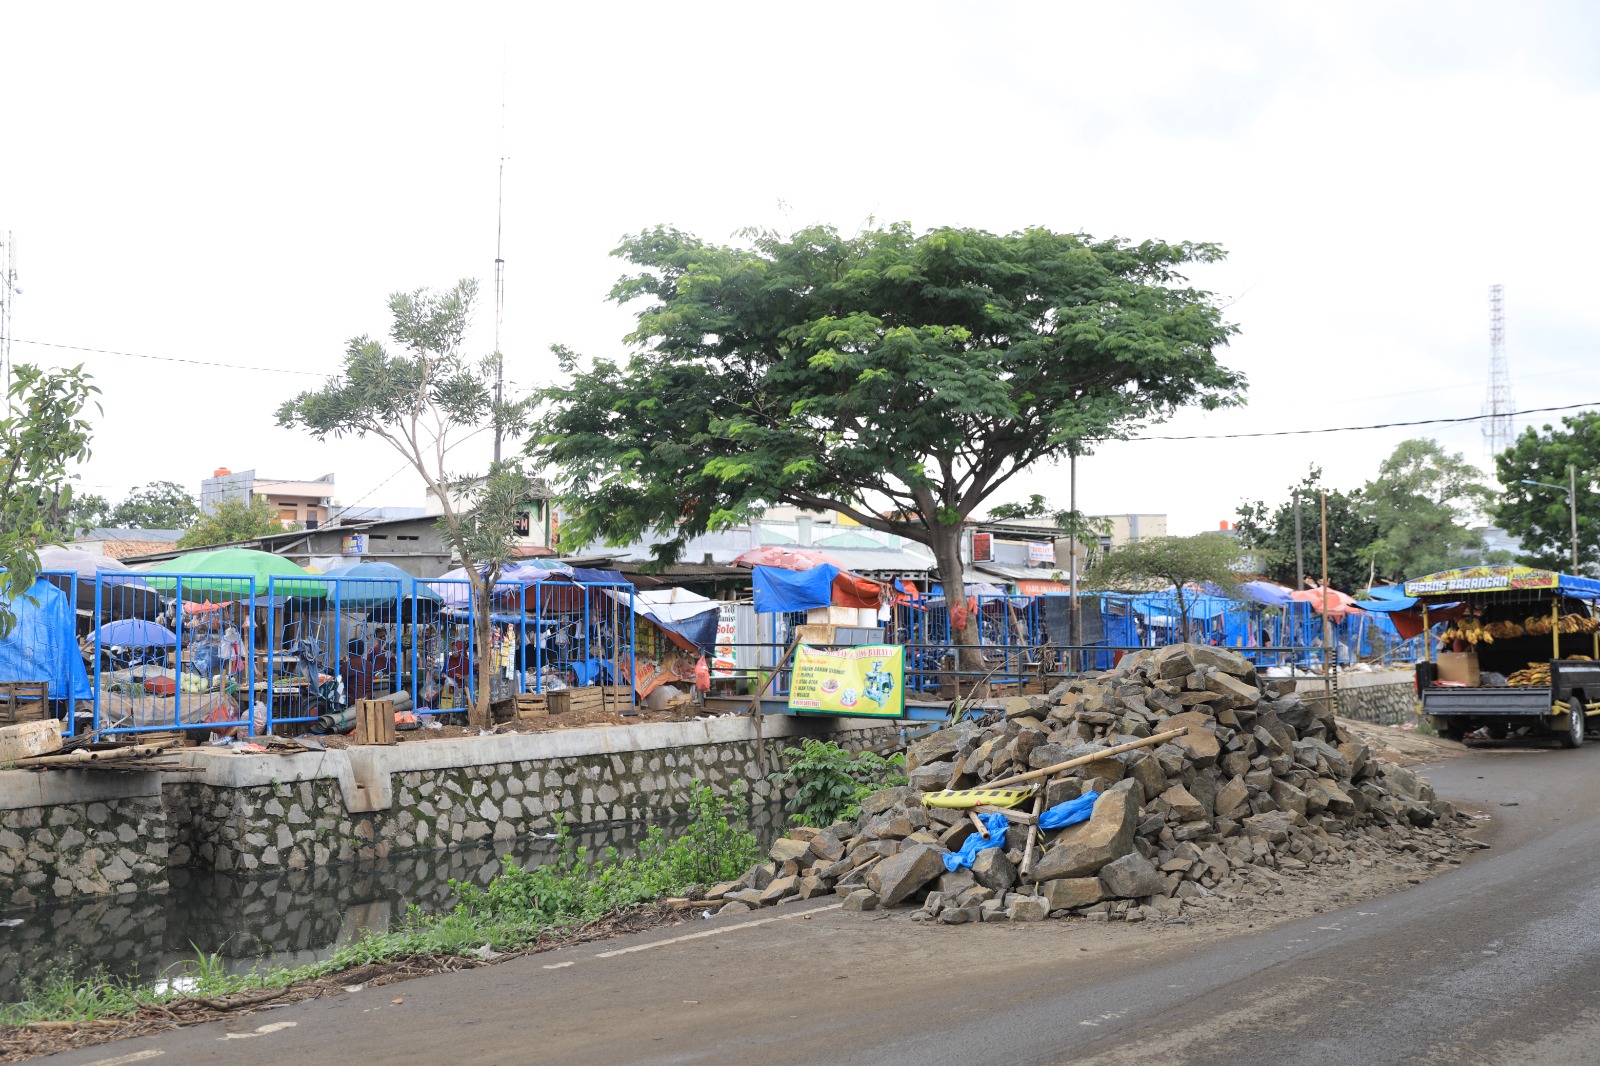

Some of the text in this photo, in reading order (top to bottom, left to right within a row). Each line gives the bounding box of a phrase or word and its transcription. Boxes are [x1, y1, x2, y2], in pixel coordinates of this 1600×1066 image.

[1408, 580, 1447, 593] PISANG
[1449, 576, 1508, 590] BARANGAN
[717, 623, 735, 634] Solo
